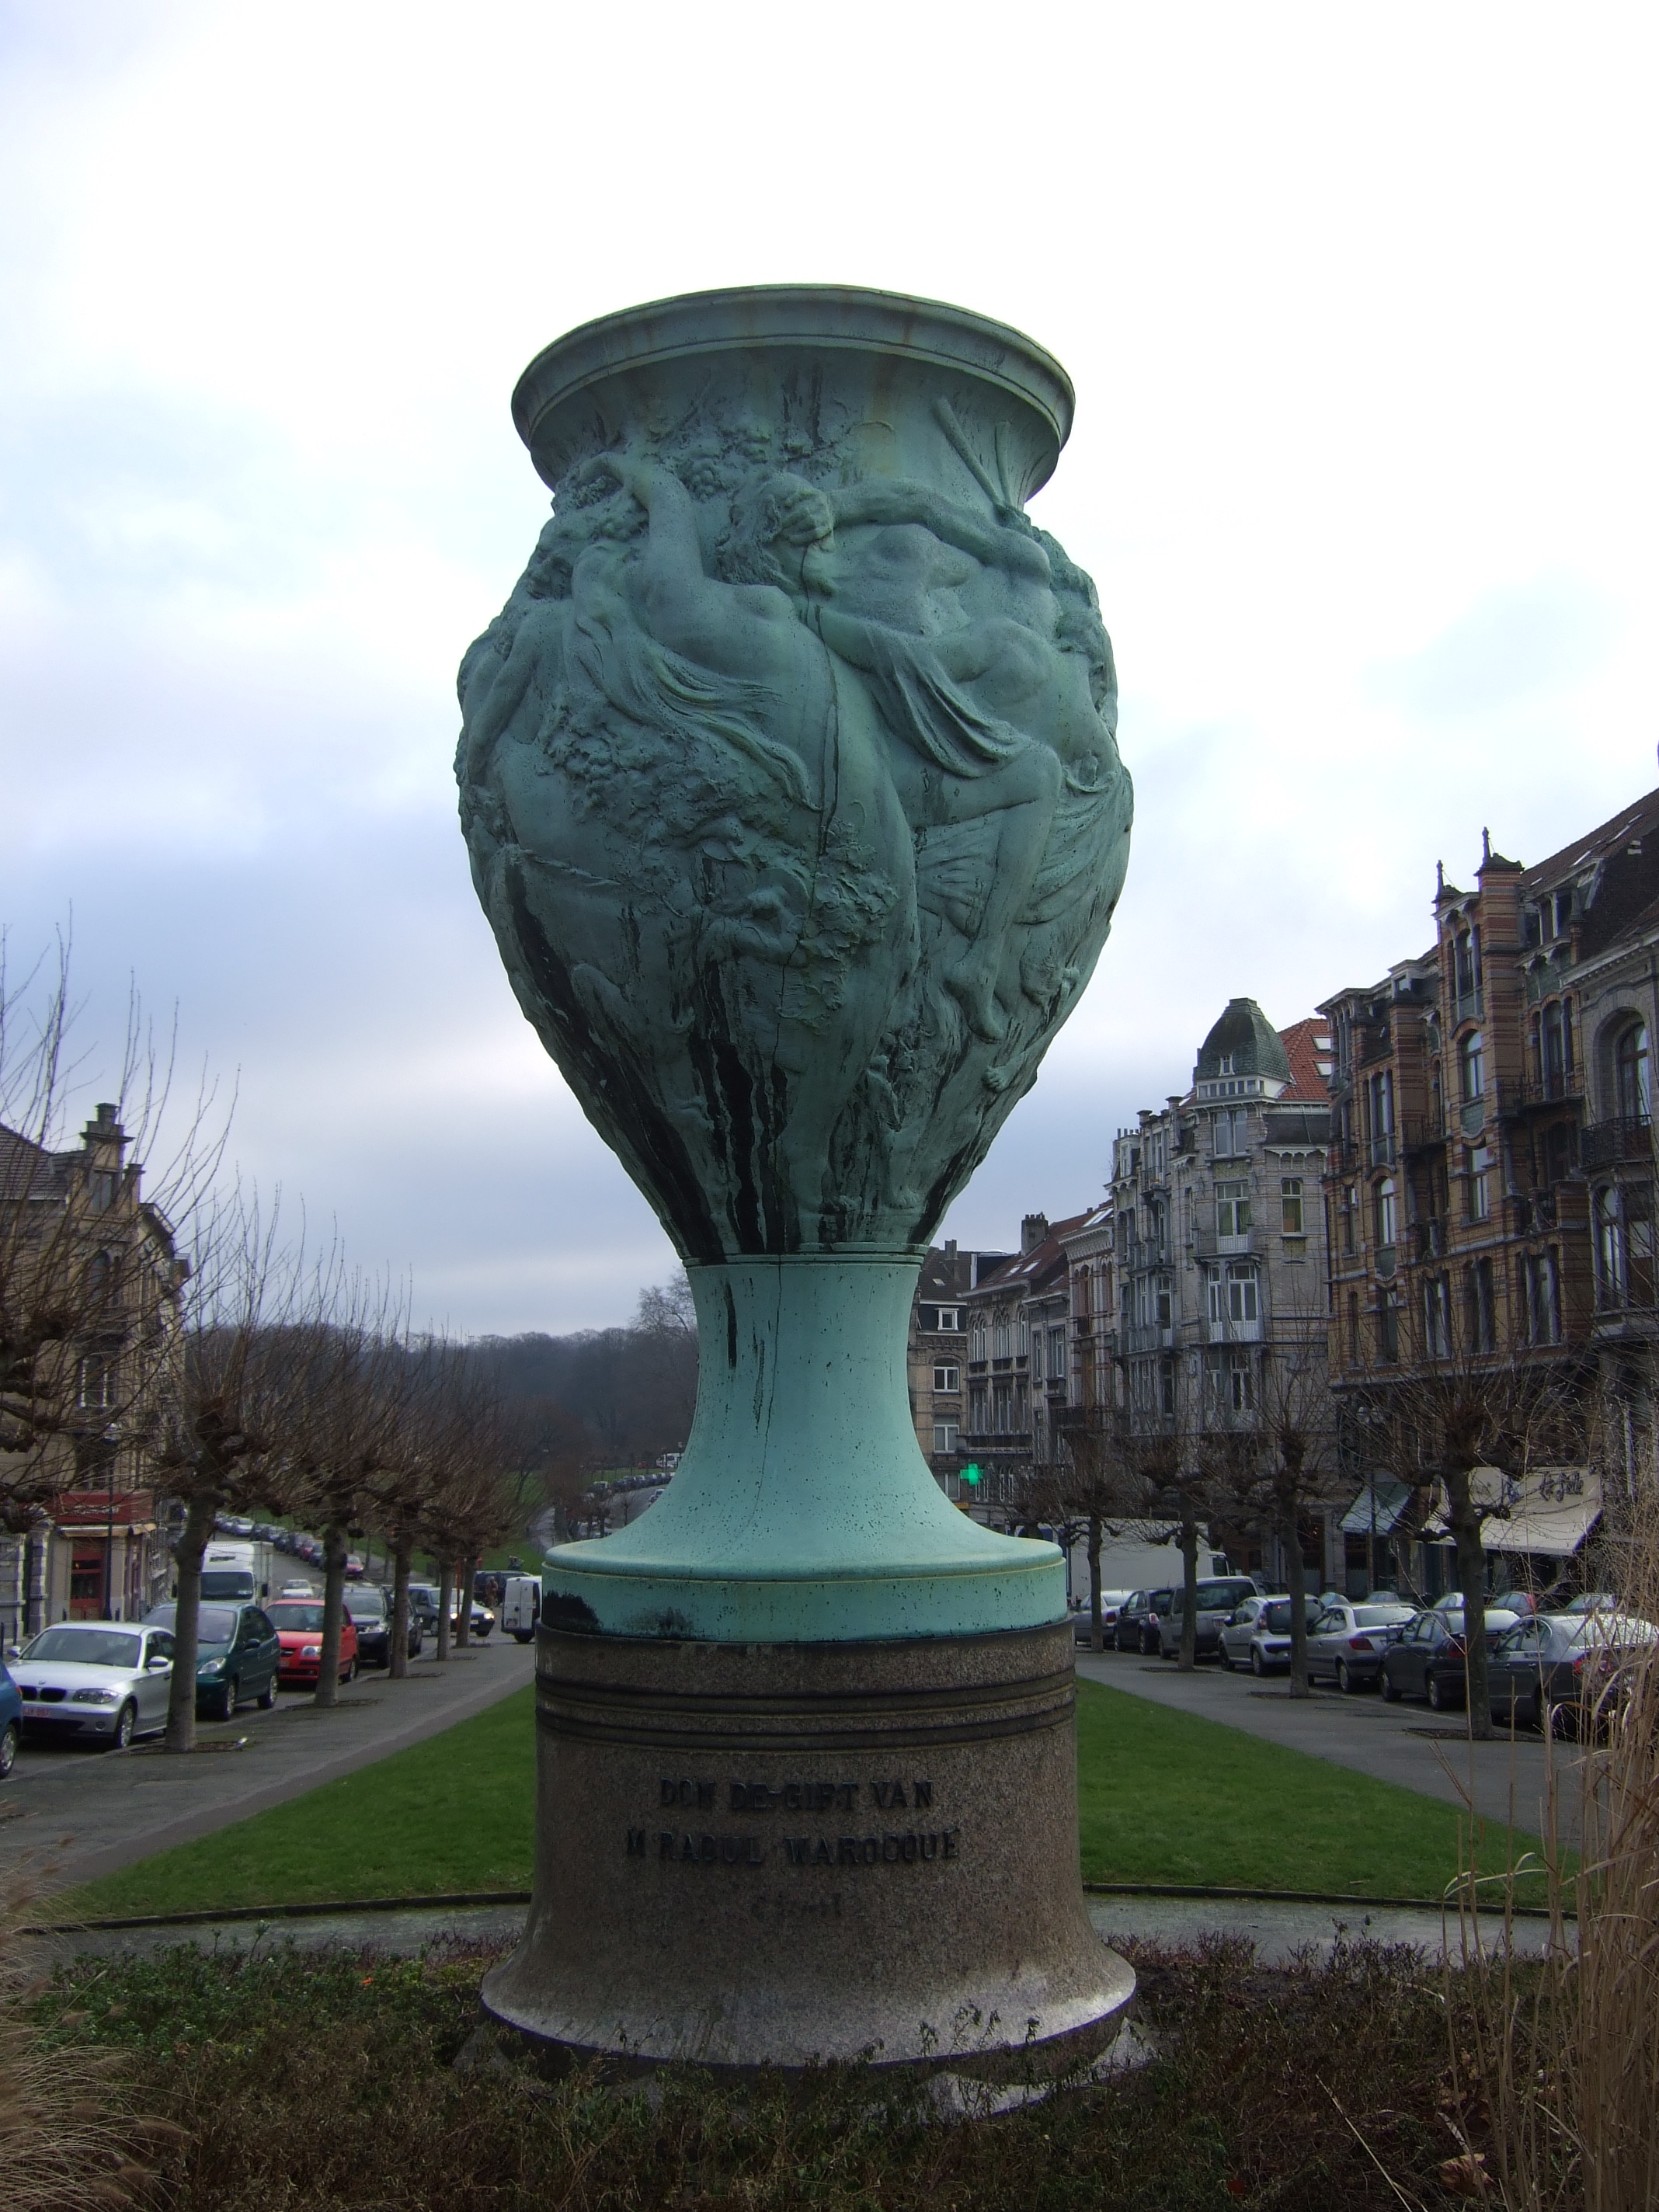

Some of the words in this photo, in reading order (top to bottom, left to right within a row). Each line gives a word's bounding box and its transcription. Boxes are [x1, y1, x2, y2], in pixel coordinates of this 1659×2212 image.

[659, 1776, 716, 1808] DON
[870, 1779, 934, 1808] VAN
[658, 1829, 765, 1865] RAOUL
